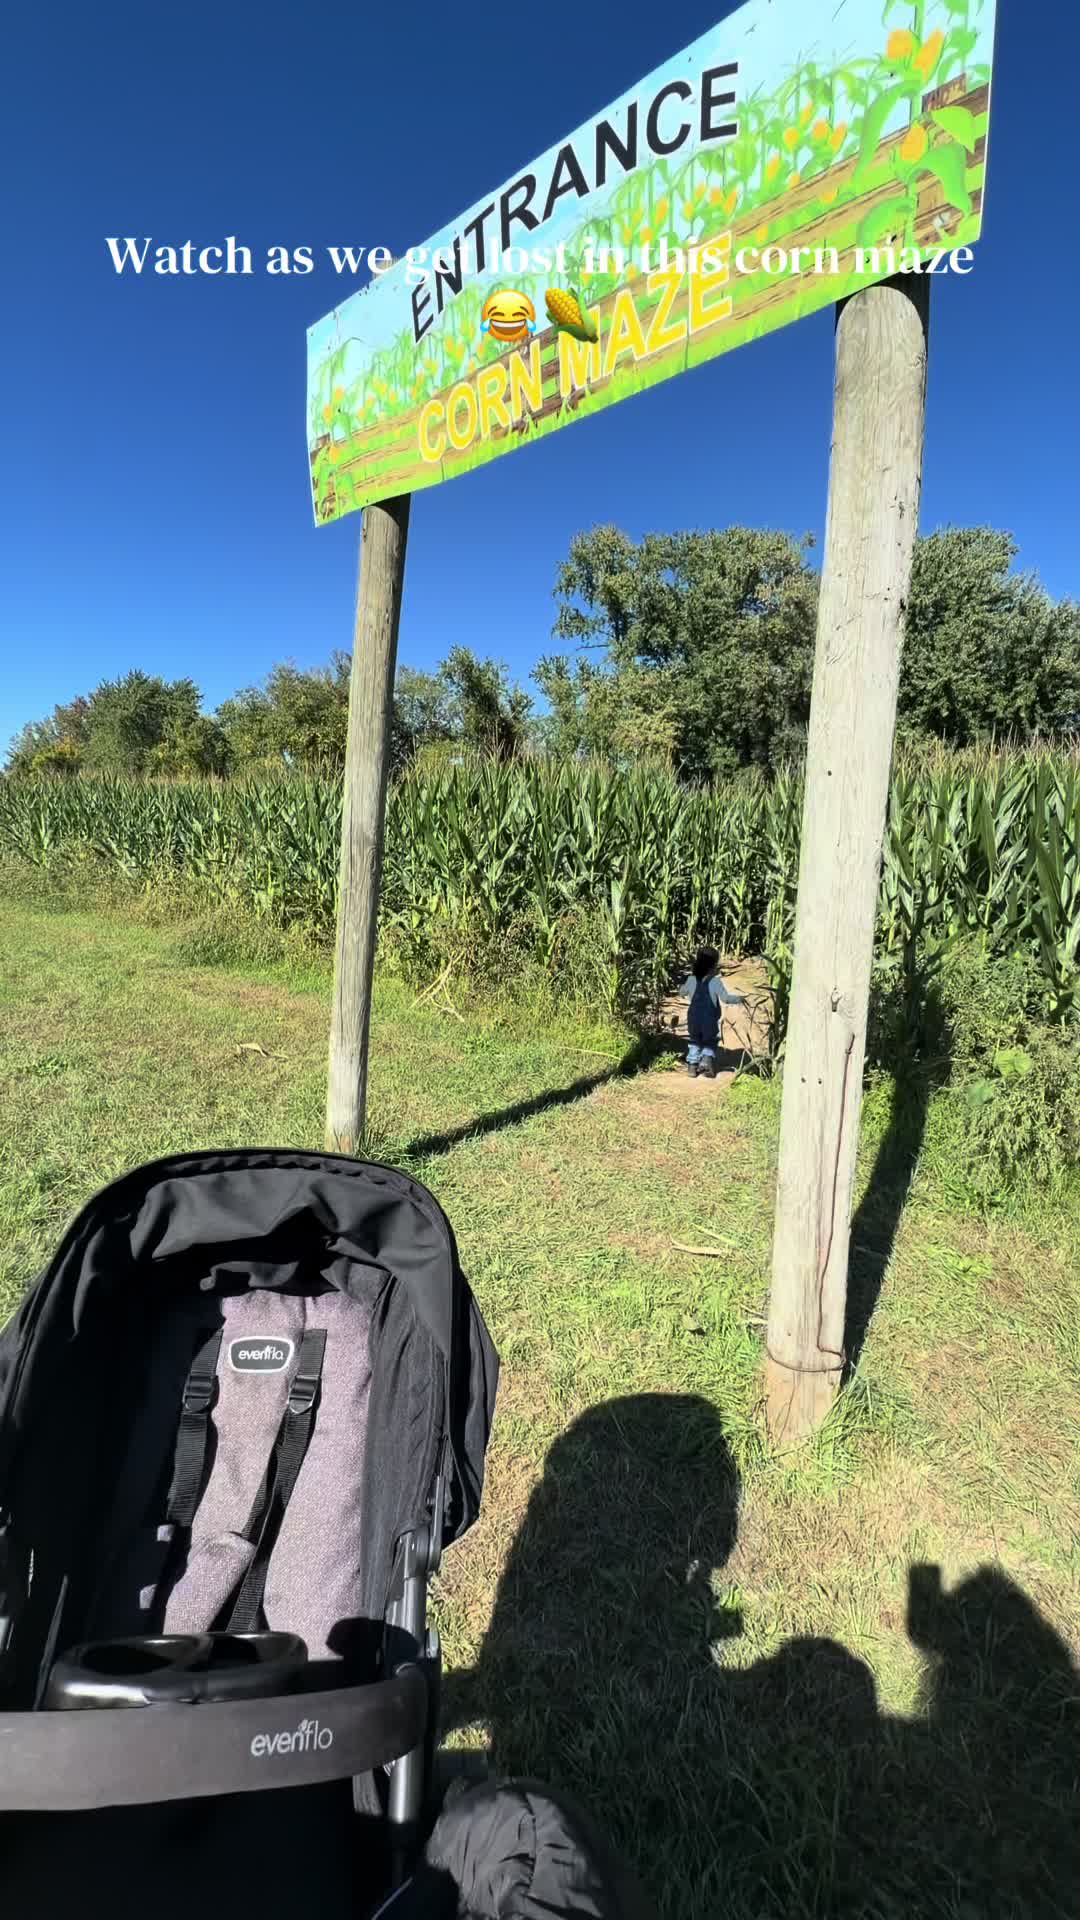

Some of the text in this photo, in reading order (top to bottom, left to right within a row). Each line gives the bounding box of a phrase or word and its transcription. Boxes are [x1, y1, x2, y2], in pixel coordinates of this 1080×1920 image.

[411, 62, 738, 344] ENTRANCE
[418, 230, 733, 464] CORN MAZE
[250, 1718, 333, 1756] evenflo
